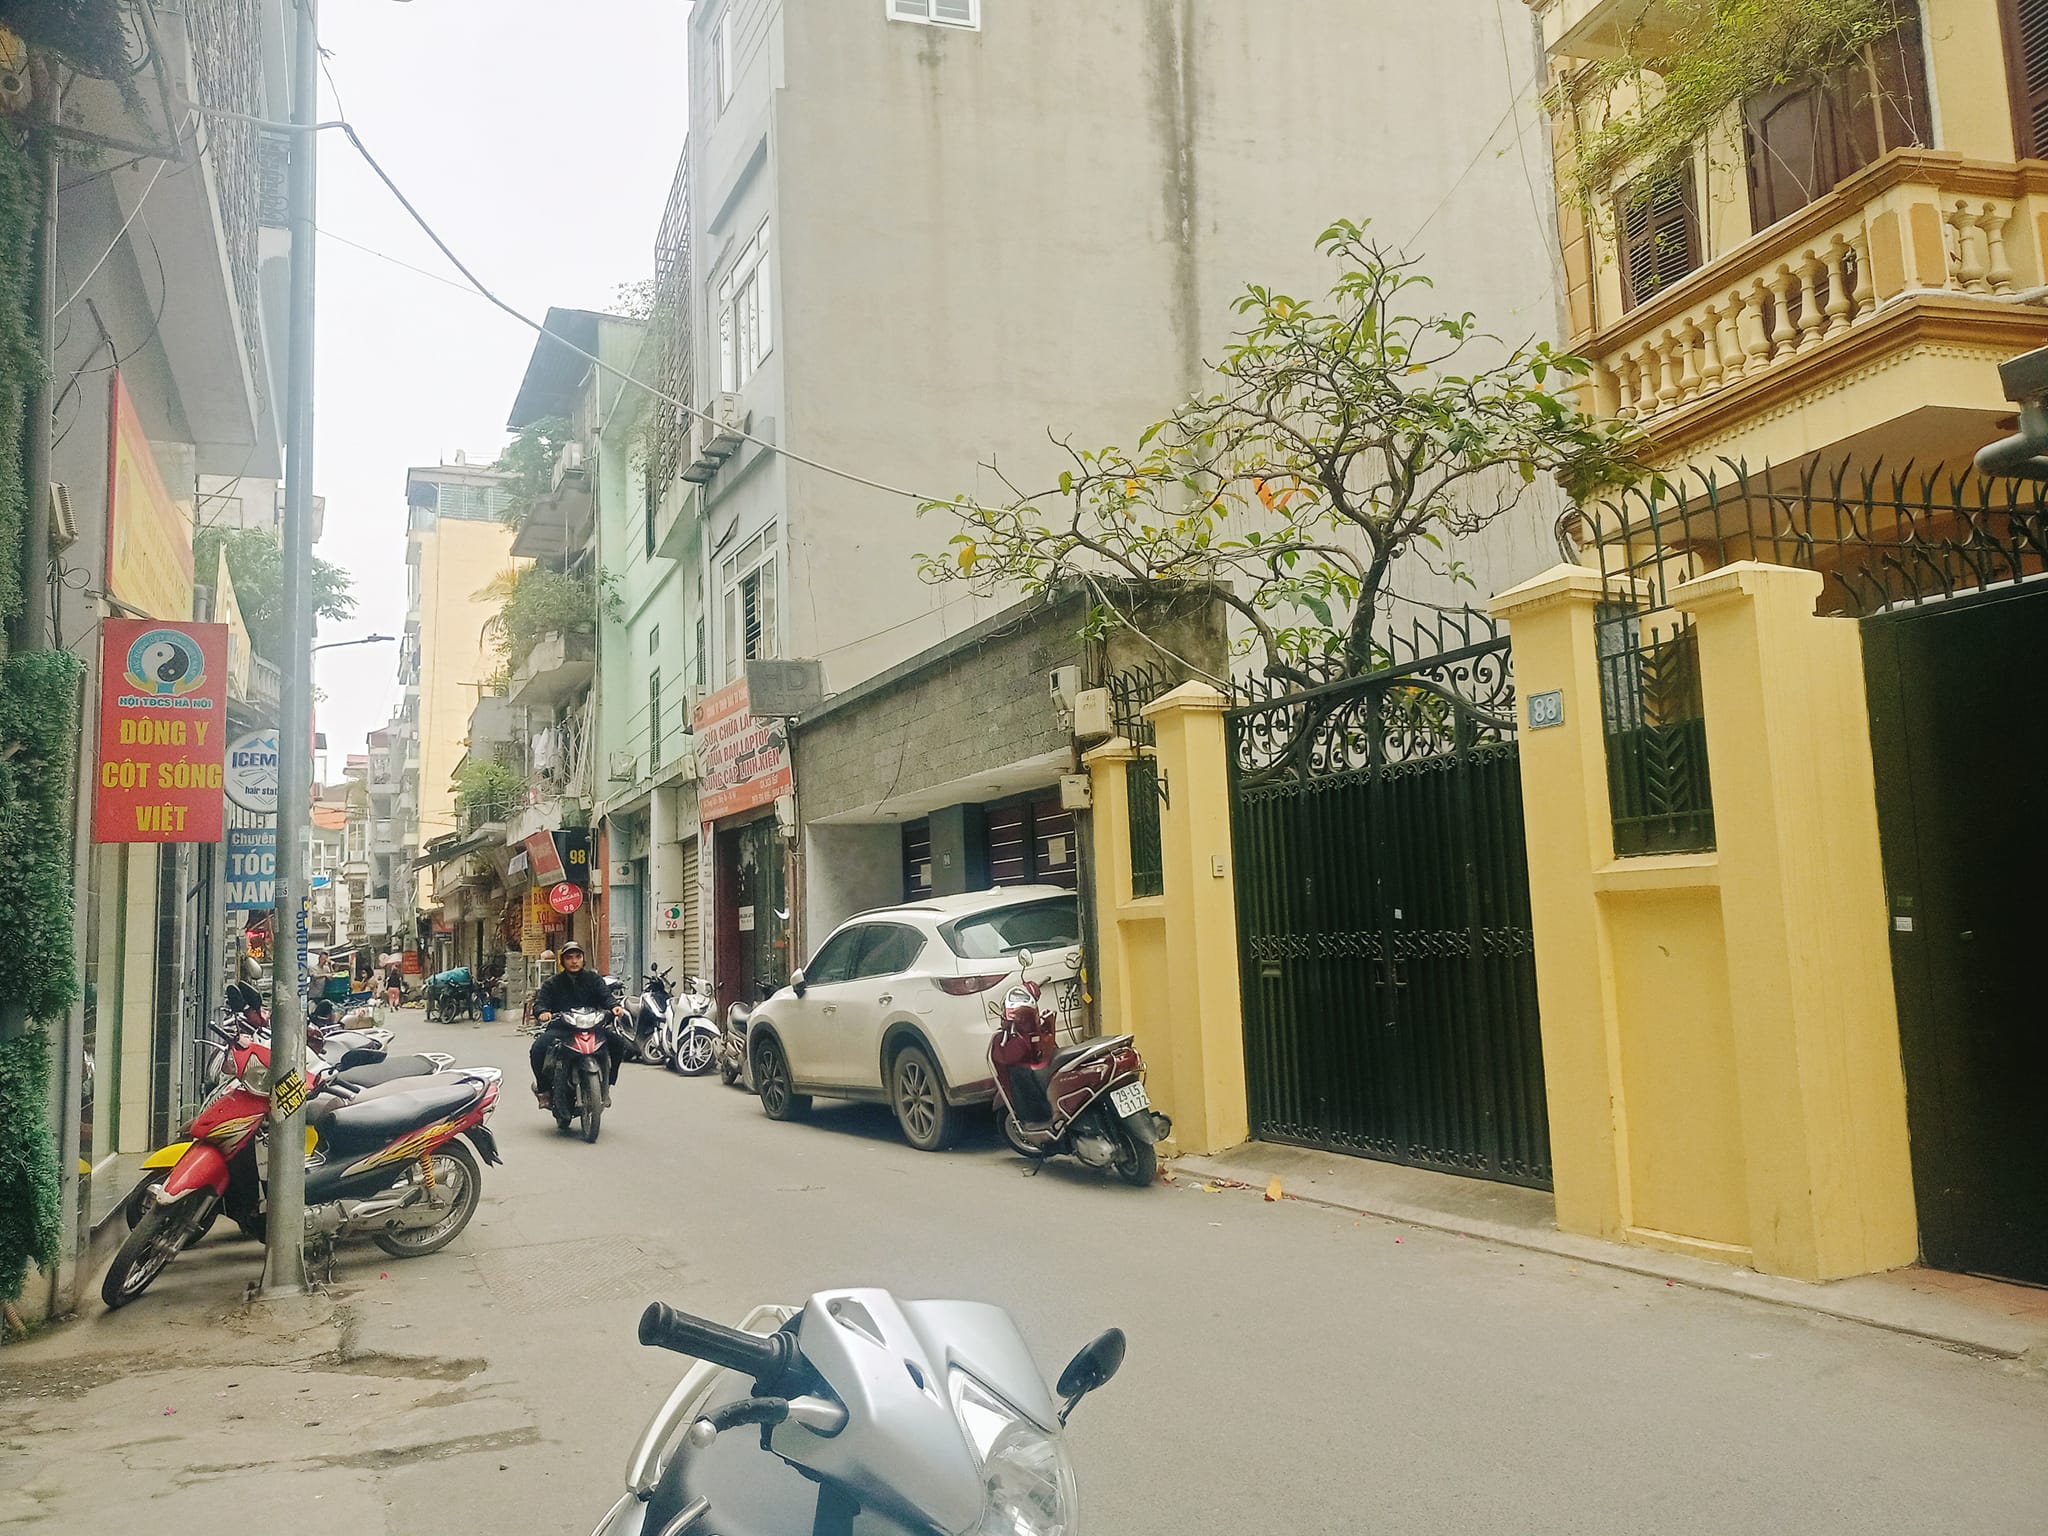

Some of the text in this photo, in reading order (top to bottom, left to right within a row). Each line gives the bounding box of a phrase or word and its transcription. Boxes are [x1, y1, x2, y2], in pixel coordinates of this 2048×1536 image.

[119, 695, 139, 708] HỘI
[1534, 697, 1557, 722] 88
[194, 721, 209, 746] Y
[719, 719, 739, 741] CHỮA
[706, 749, 722, 769] MUA
[102, 755, 222, 792] CỘT SỐNG
[703, 772, 724, 792] CUNG
[245, 786, 260, 795] hair
[136, 802, 188, 836] VIỆT
[232, 832, 275, 846] Chuyên
[231, 848, 276, 875] TÓC
[570, 849, 586, 864] 98
[226, 881, 275, 903] NAM
[665, 920, 678, 929] 96
[1117, 1085, 1141, 1101] 29-L5
